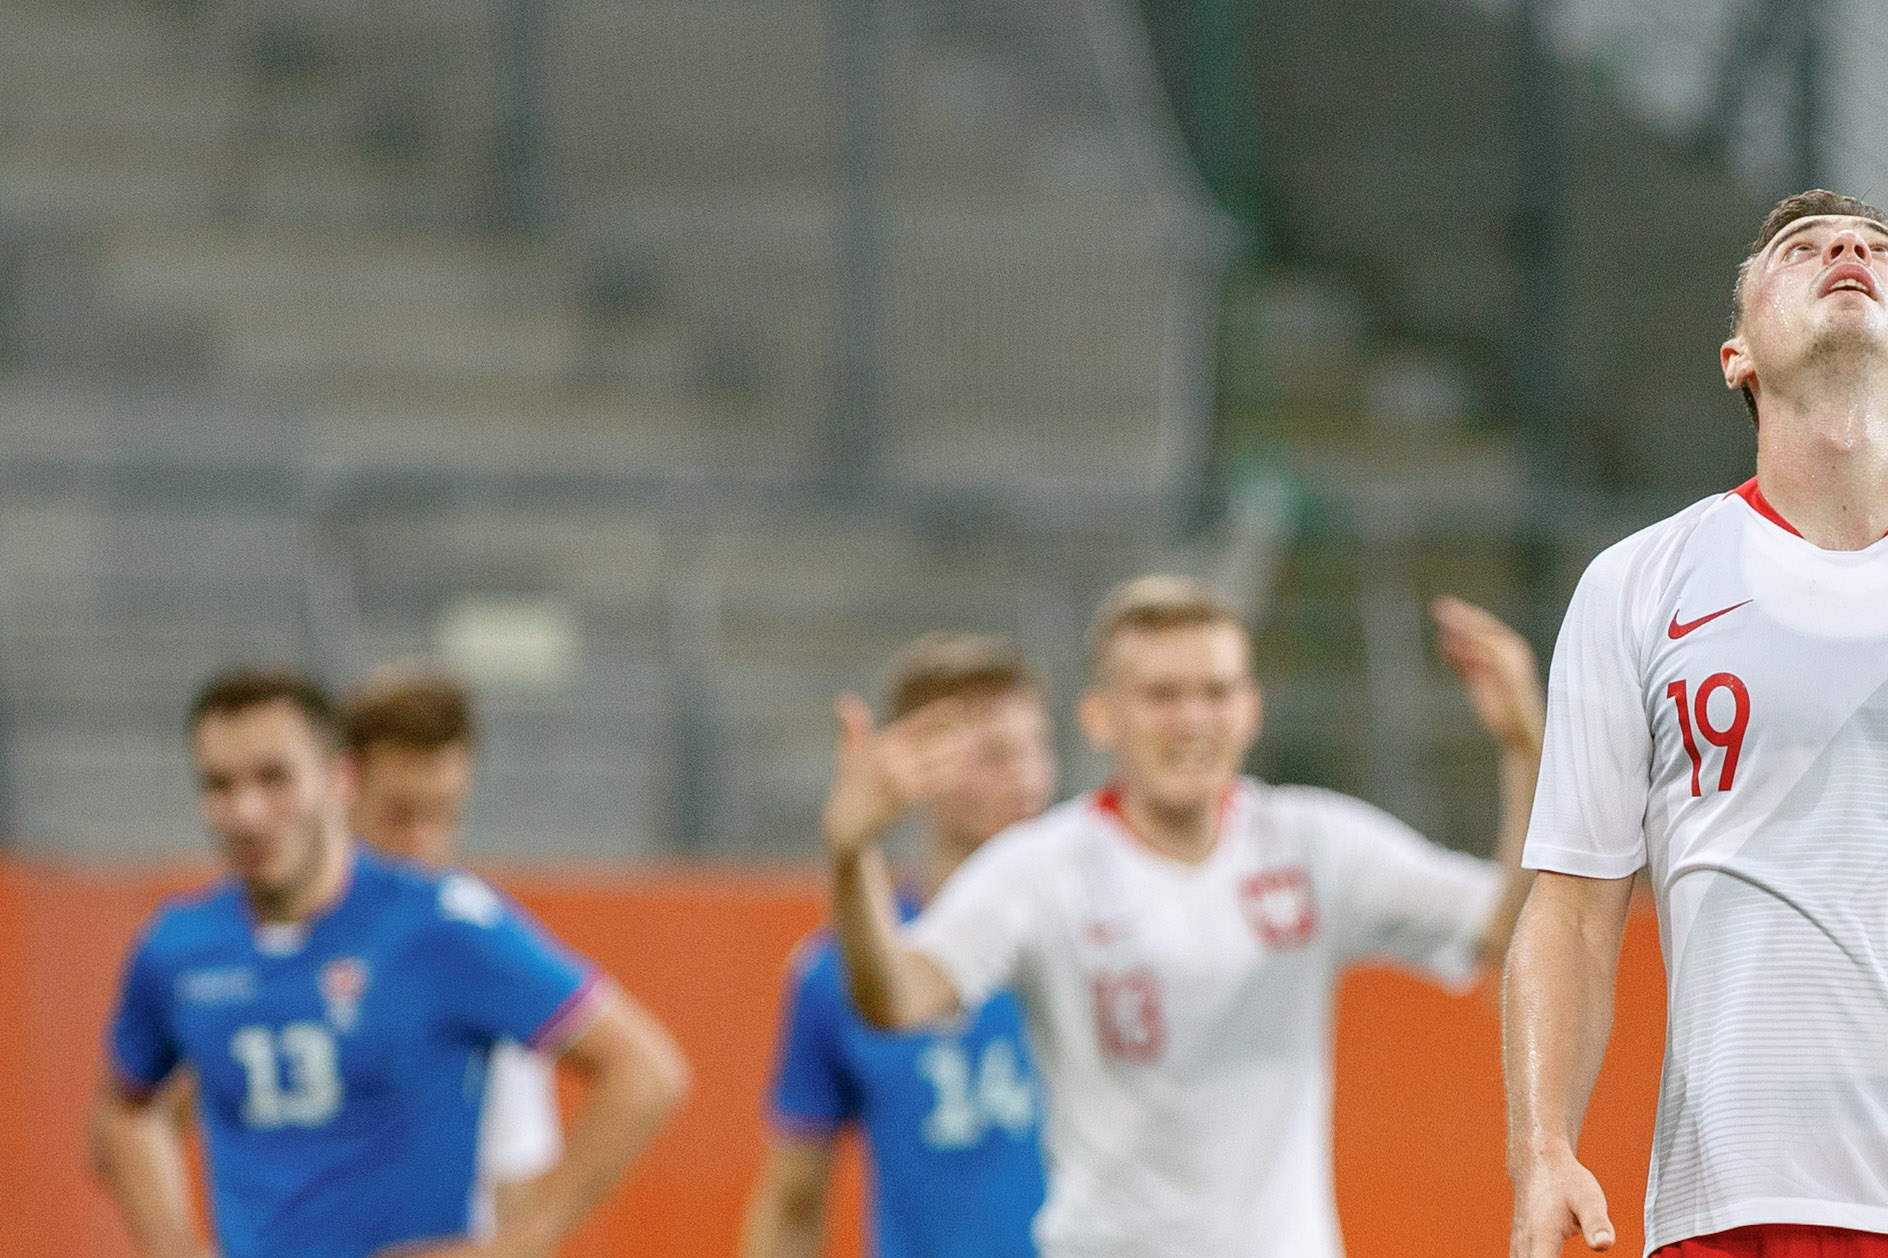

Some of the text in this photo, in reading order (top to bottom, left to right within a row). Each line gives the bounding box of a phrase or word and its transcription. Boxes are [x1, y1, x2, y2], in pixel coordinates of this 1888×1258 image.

[1667, 672, 1751, 797] 19
[1092, 967, 1165, 1065] 13
[229, 1020, 344, 1130] 13
[914, 1040, 1036, 1151] 14
